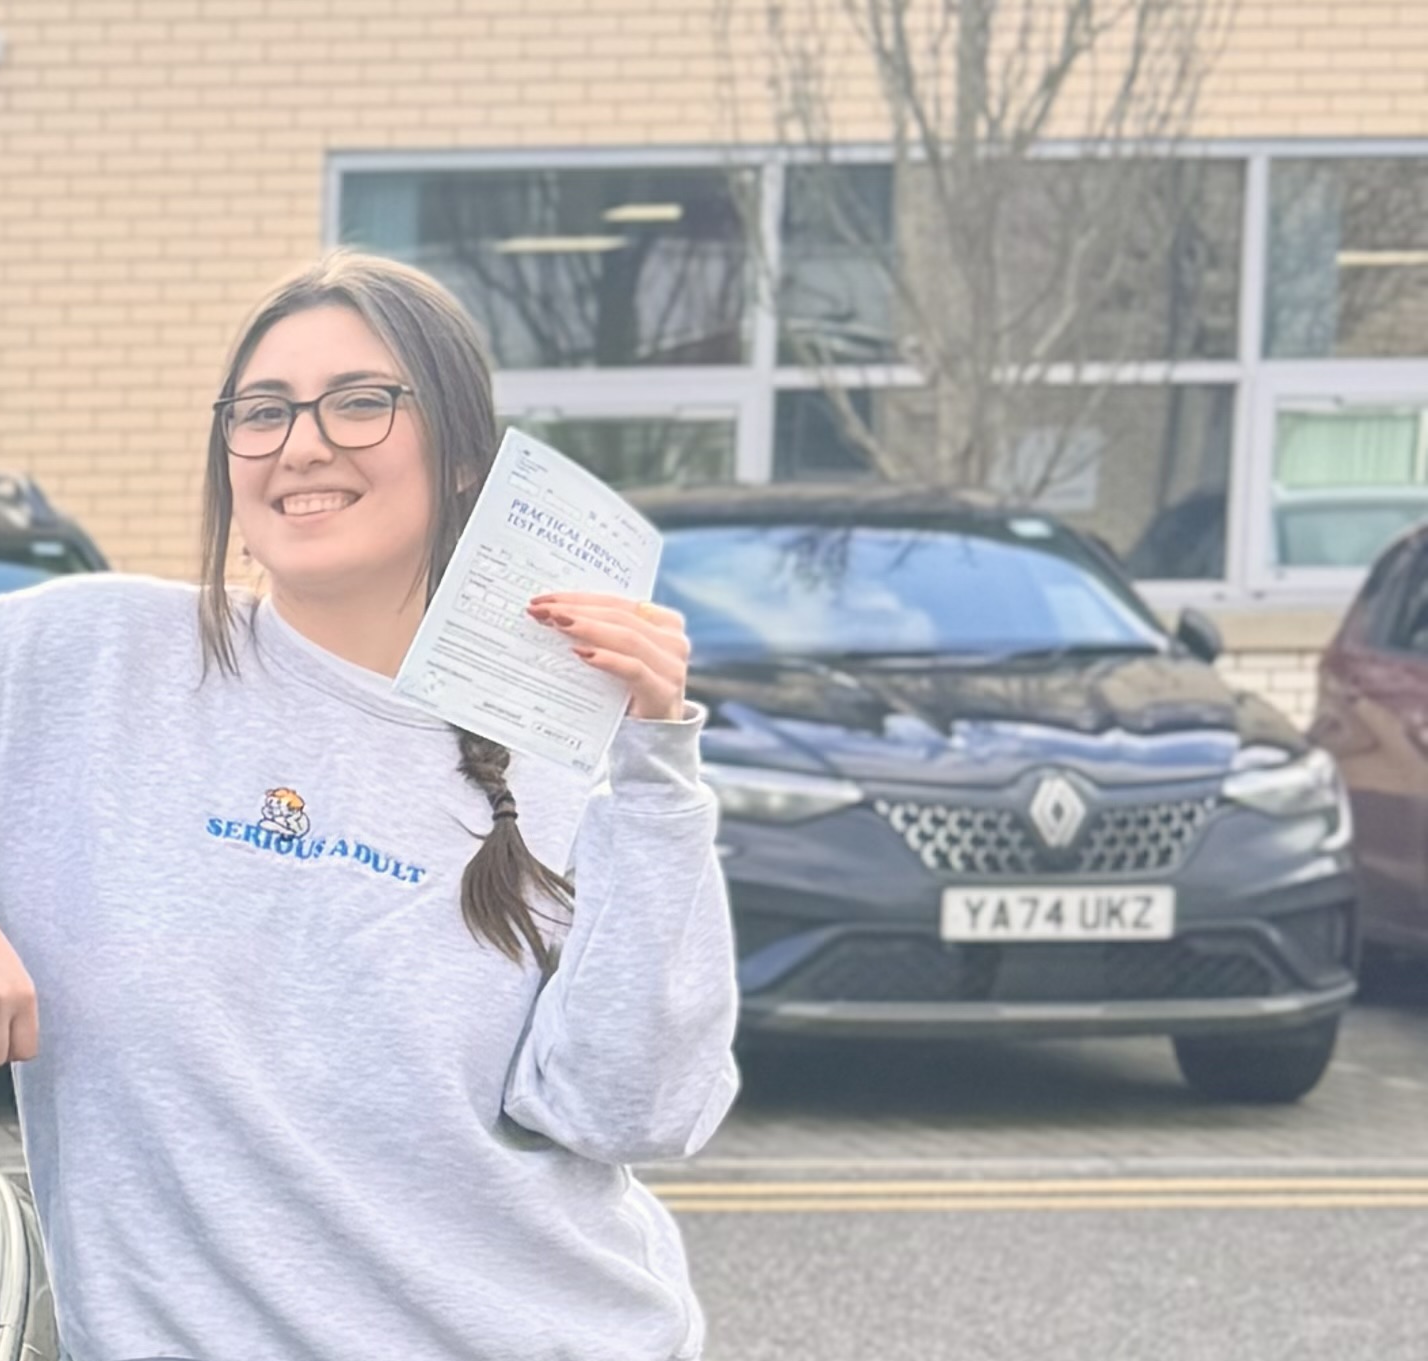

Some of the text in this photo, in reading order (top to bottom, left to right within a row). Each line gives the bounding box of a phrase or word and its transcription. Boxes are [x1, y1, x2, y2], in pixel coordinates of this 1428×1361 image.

[507, 513, 535, 535] TEST
[536, 525, 566, 551] PASS
[510, 498, 580, 544] PRACTICAL
[206, 817, 427, 884] SERIOUS ADULT
[962, 895, 1154, 931] YA74 UKZ
